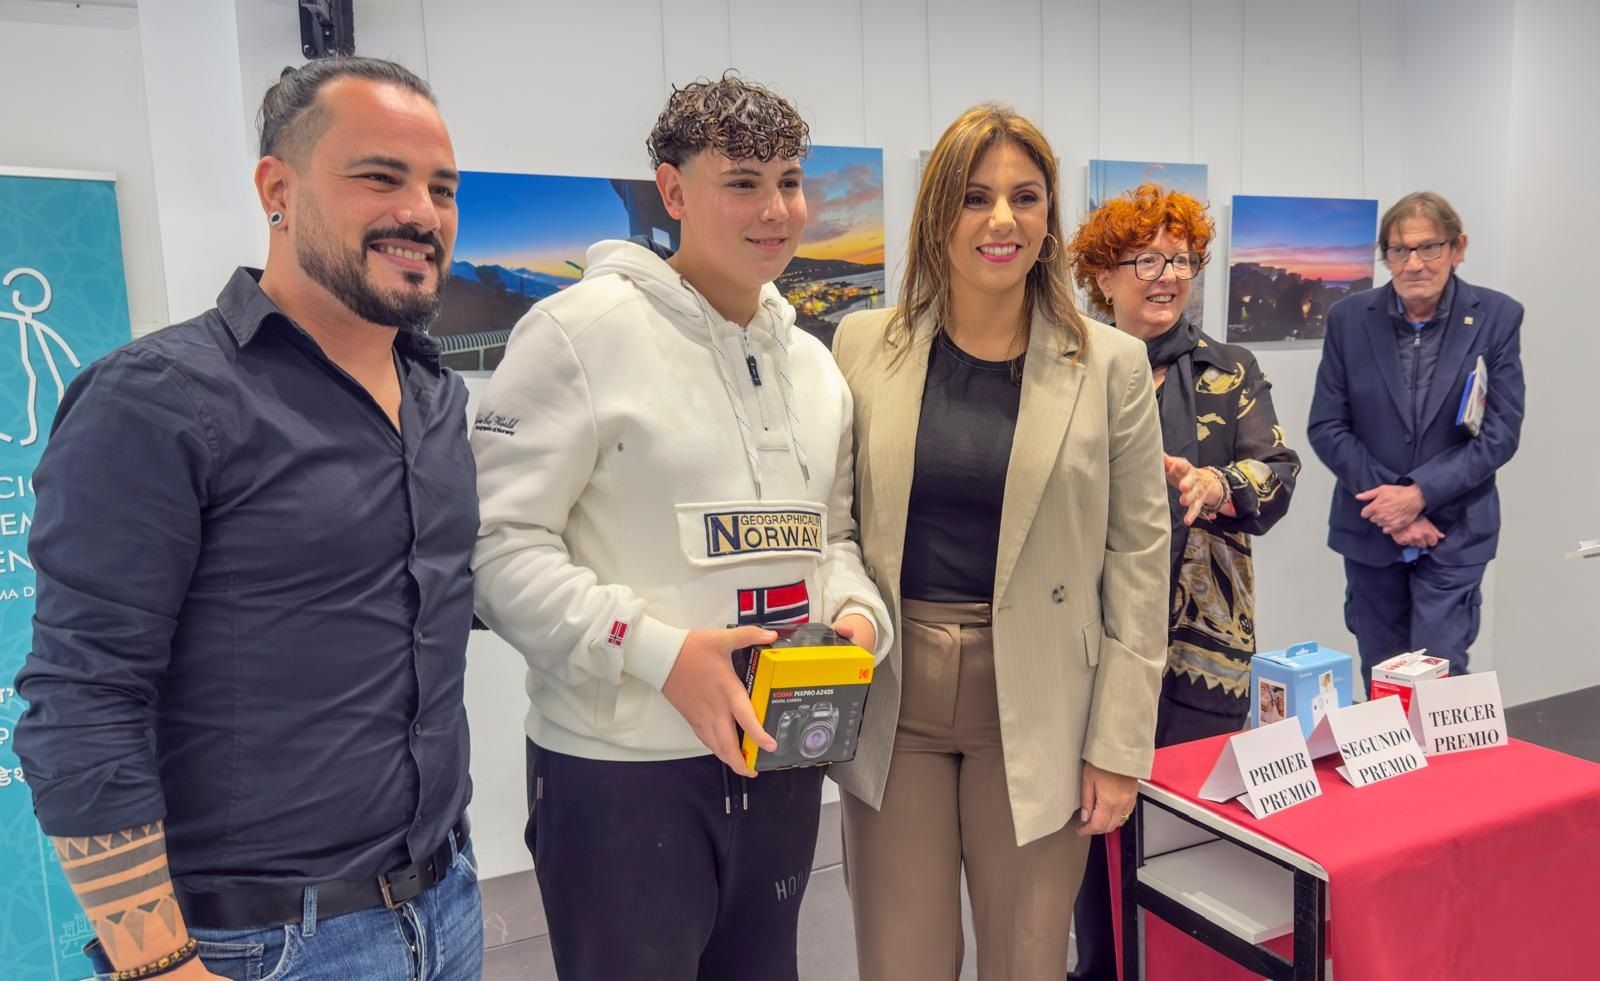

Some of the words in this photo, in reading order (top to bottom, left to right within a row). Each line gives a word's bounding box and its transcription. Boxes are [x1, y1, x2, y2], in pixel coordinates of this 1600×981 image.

[710, 515, 818, 553] NORWAY
[1428, 703, 1496, 728] TERCER
[1340, 727, 1411, 760] SEGUNDO
[1434, 728, 1499, 753] PREMIO
[1248, 752, 1308, 787] PRIMER
[1358, 753, 1417, 784] PREMIO
[1259, 779, 1317, 814] PREMIO
